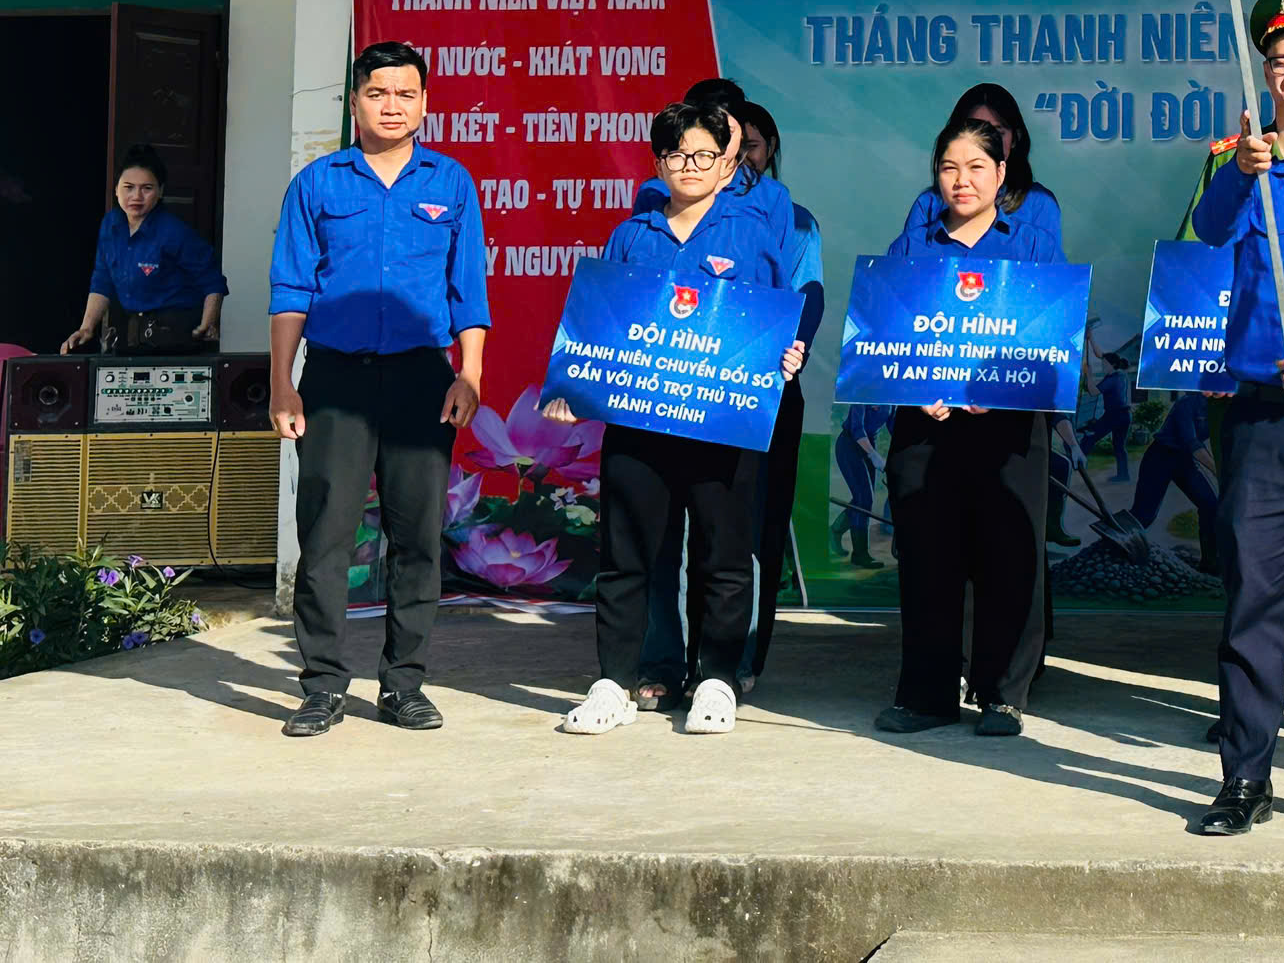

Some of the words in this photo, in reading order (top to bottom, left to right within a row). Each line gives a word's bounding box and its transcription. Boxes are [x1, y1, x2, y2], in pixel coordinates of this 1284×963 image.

[804, 2, 957, 64] THÁNG
[971, 13, 1127, 63] THANH
[437, 40, 506, 76] NƯỚC
[528, 40, 593, 76] KHÁT
[599, 46, 666, 81] VỌNG
[451, 101, 499, 142] KẾT
[523, 106, 578, 142] TIÊN
[584, 112, 660, 142] PHON
[1150, 79, 1225, 141] ĐỜI
[480, 179, 530, 214] TẠO
[553, 179, 585, 214] TỰ
[591, 179, 634, 209] TIN
[913, 311, 955, 338] ĐỘI
[961, 312, 1017, 336] HÌNH
[1164, 315, 1217, 330] THANH
[628, 323, 666, 349] ĐỘI
[671, 326, 722, 355] HÌNH
[855, 341, 911, 356] THANH
[915, 340, 954, 358] NIÊN
[959, 341, 996, 360] TÌNH
[1001, 344, 1069, 366] NGUYỆN
[1154, 333, 1170, 350] VÌ
[1173, 337, 1197, 351] AN
[564, 340, 614, 362] THANH
[617, 347, 652, 368] NIÊN
[751, 370, 776, 389] SỐ
[882, 361, 899, 380] VÌ
[902, 365, 929, 381] AN
[932, 367, 971, 382] SINH
[975, 365, 1000, 382] XÃ
[1005, 367, 1036, 388] HỘI
[1170, 358, 1194, 373] AN
[605, 369, 633, 388] VỚI
[663, 380, 694, 401] TRỢ
[696, 385, 726, 404] THỦ
[728, 392, 759, 412] TỤC
[607, 393, 652, 414] HÀNH
[655, 400, 706, 424] CHÍNH
